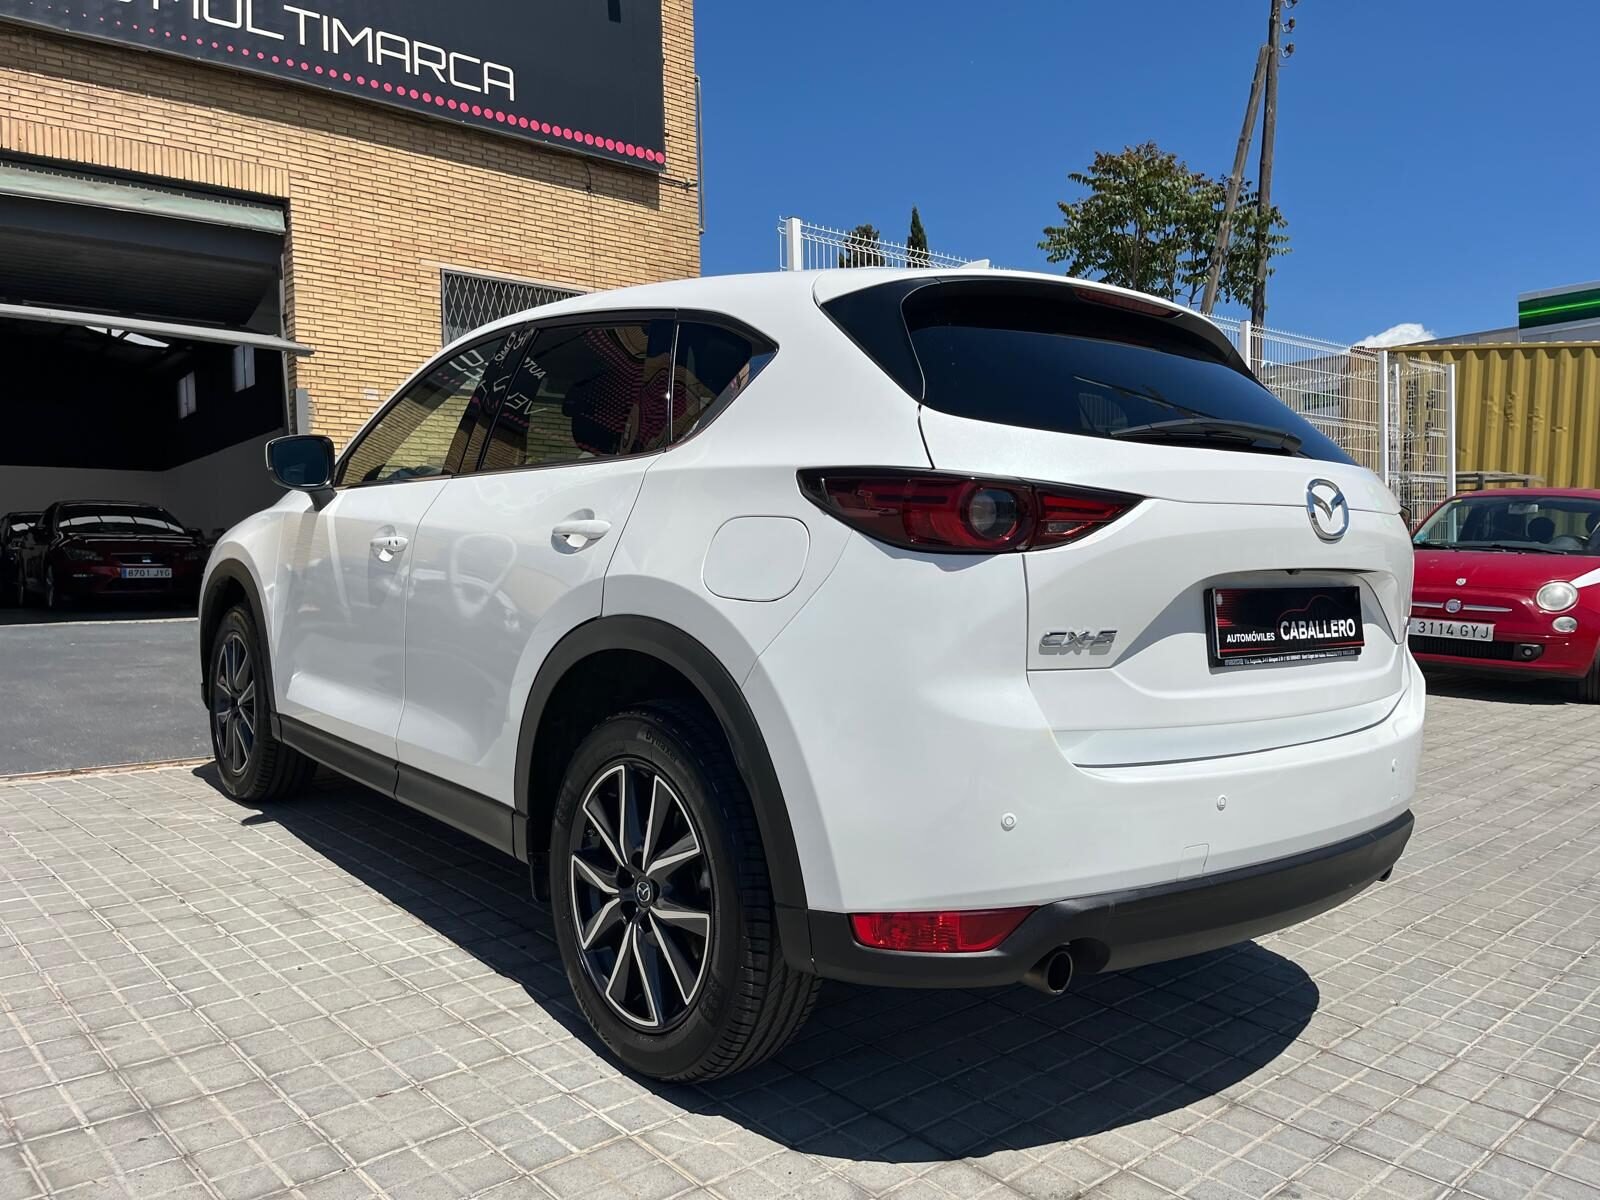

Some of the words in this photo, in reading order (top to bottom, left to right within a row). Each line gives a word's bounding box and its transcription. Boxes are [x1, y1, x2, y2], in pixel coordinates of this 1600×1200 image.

[128, 569, 150, 577] 8701
[1039, 629, 1118, 651] CX-5
[1226, 631, 1276, 643] AUTOMÓVILES
[1280, 618, 1356, 641] CABALLERO
[1417, 621, 1455, 636] 3114
[1460, 625, 1490, 639] GYJ
